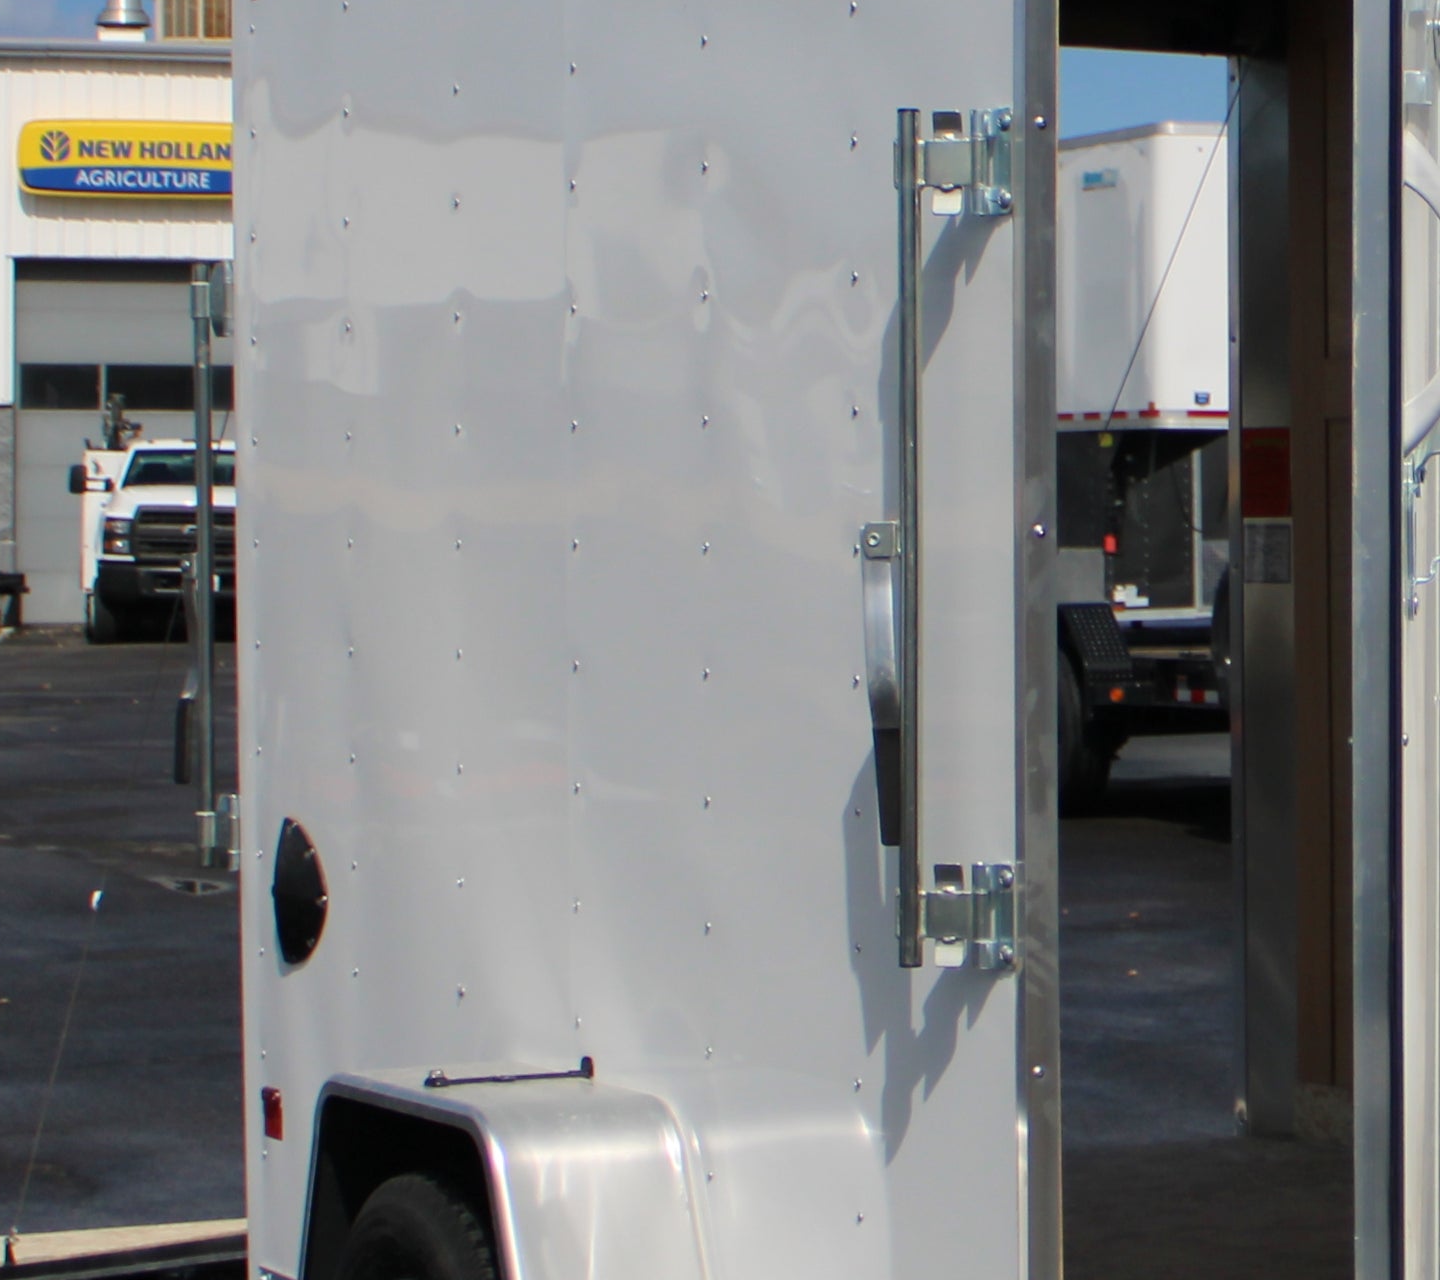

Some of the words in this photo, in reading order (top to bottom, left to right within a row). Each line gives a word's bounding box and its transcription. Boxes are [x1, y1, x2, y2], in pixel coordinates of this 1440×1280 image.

[77, 139, 134, 158] NEW
[138, 140, 233, 160] HOLLAN
[76, 169, 210, 189] AGRICULTURE
